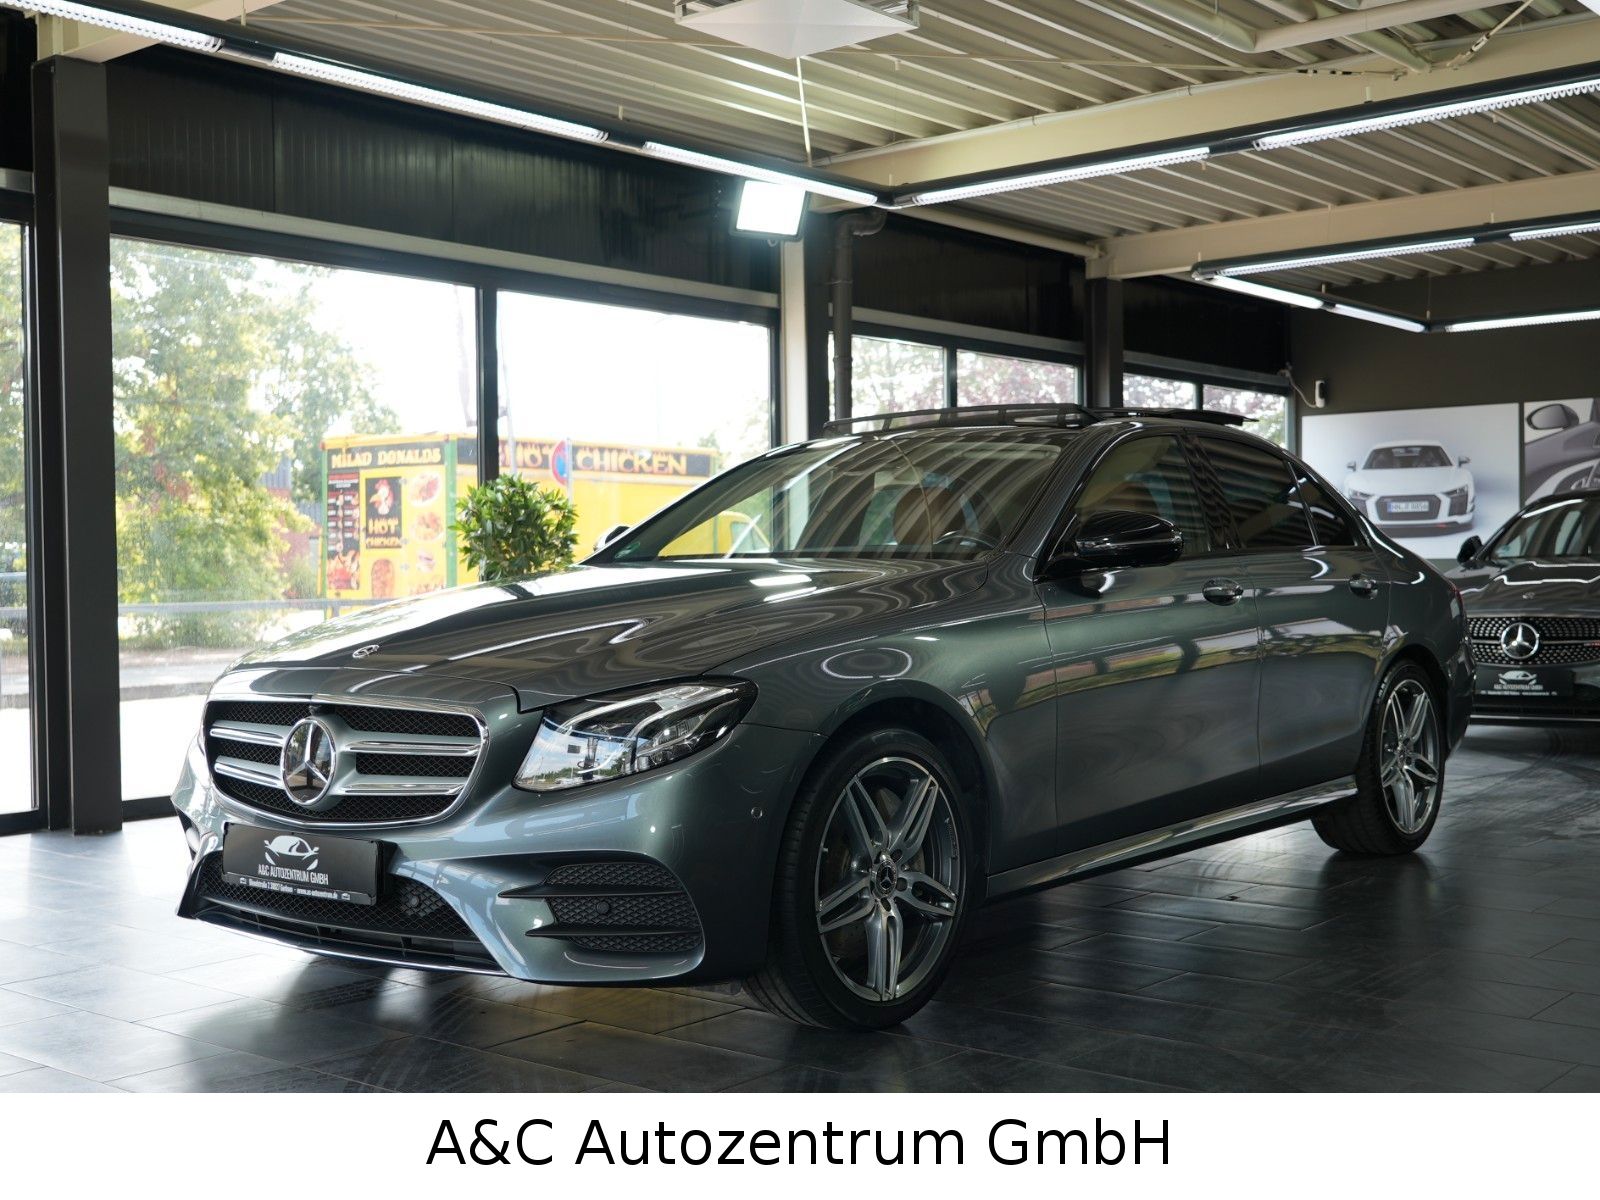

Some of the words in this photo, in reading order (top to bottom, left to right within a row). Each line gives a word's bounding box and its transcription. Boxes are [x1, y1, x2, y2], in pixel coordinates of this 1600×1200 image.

[377, 448, 441, 466] DONALDS
[576, 445, 687, 475] CHICKEN
[367, 518, 399, 534] HOT
[258, 864, 270, 876] A&C
[270, 866, 310, 882] AUTOZENTRUM
[310, 872, 329, 885] GMBH
